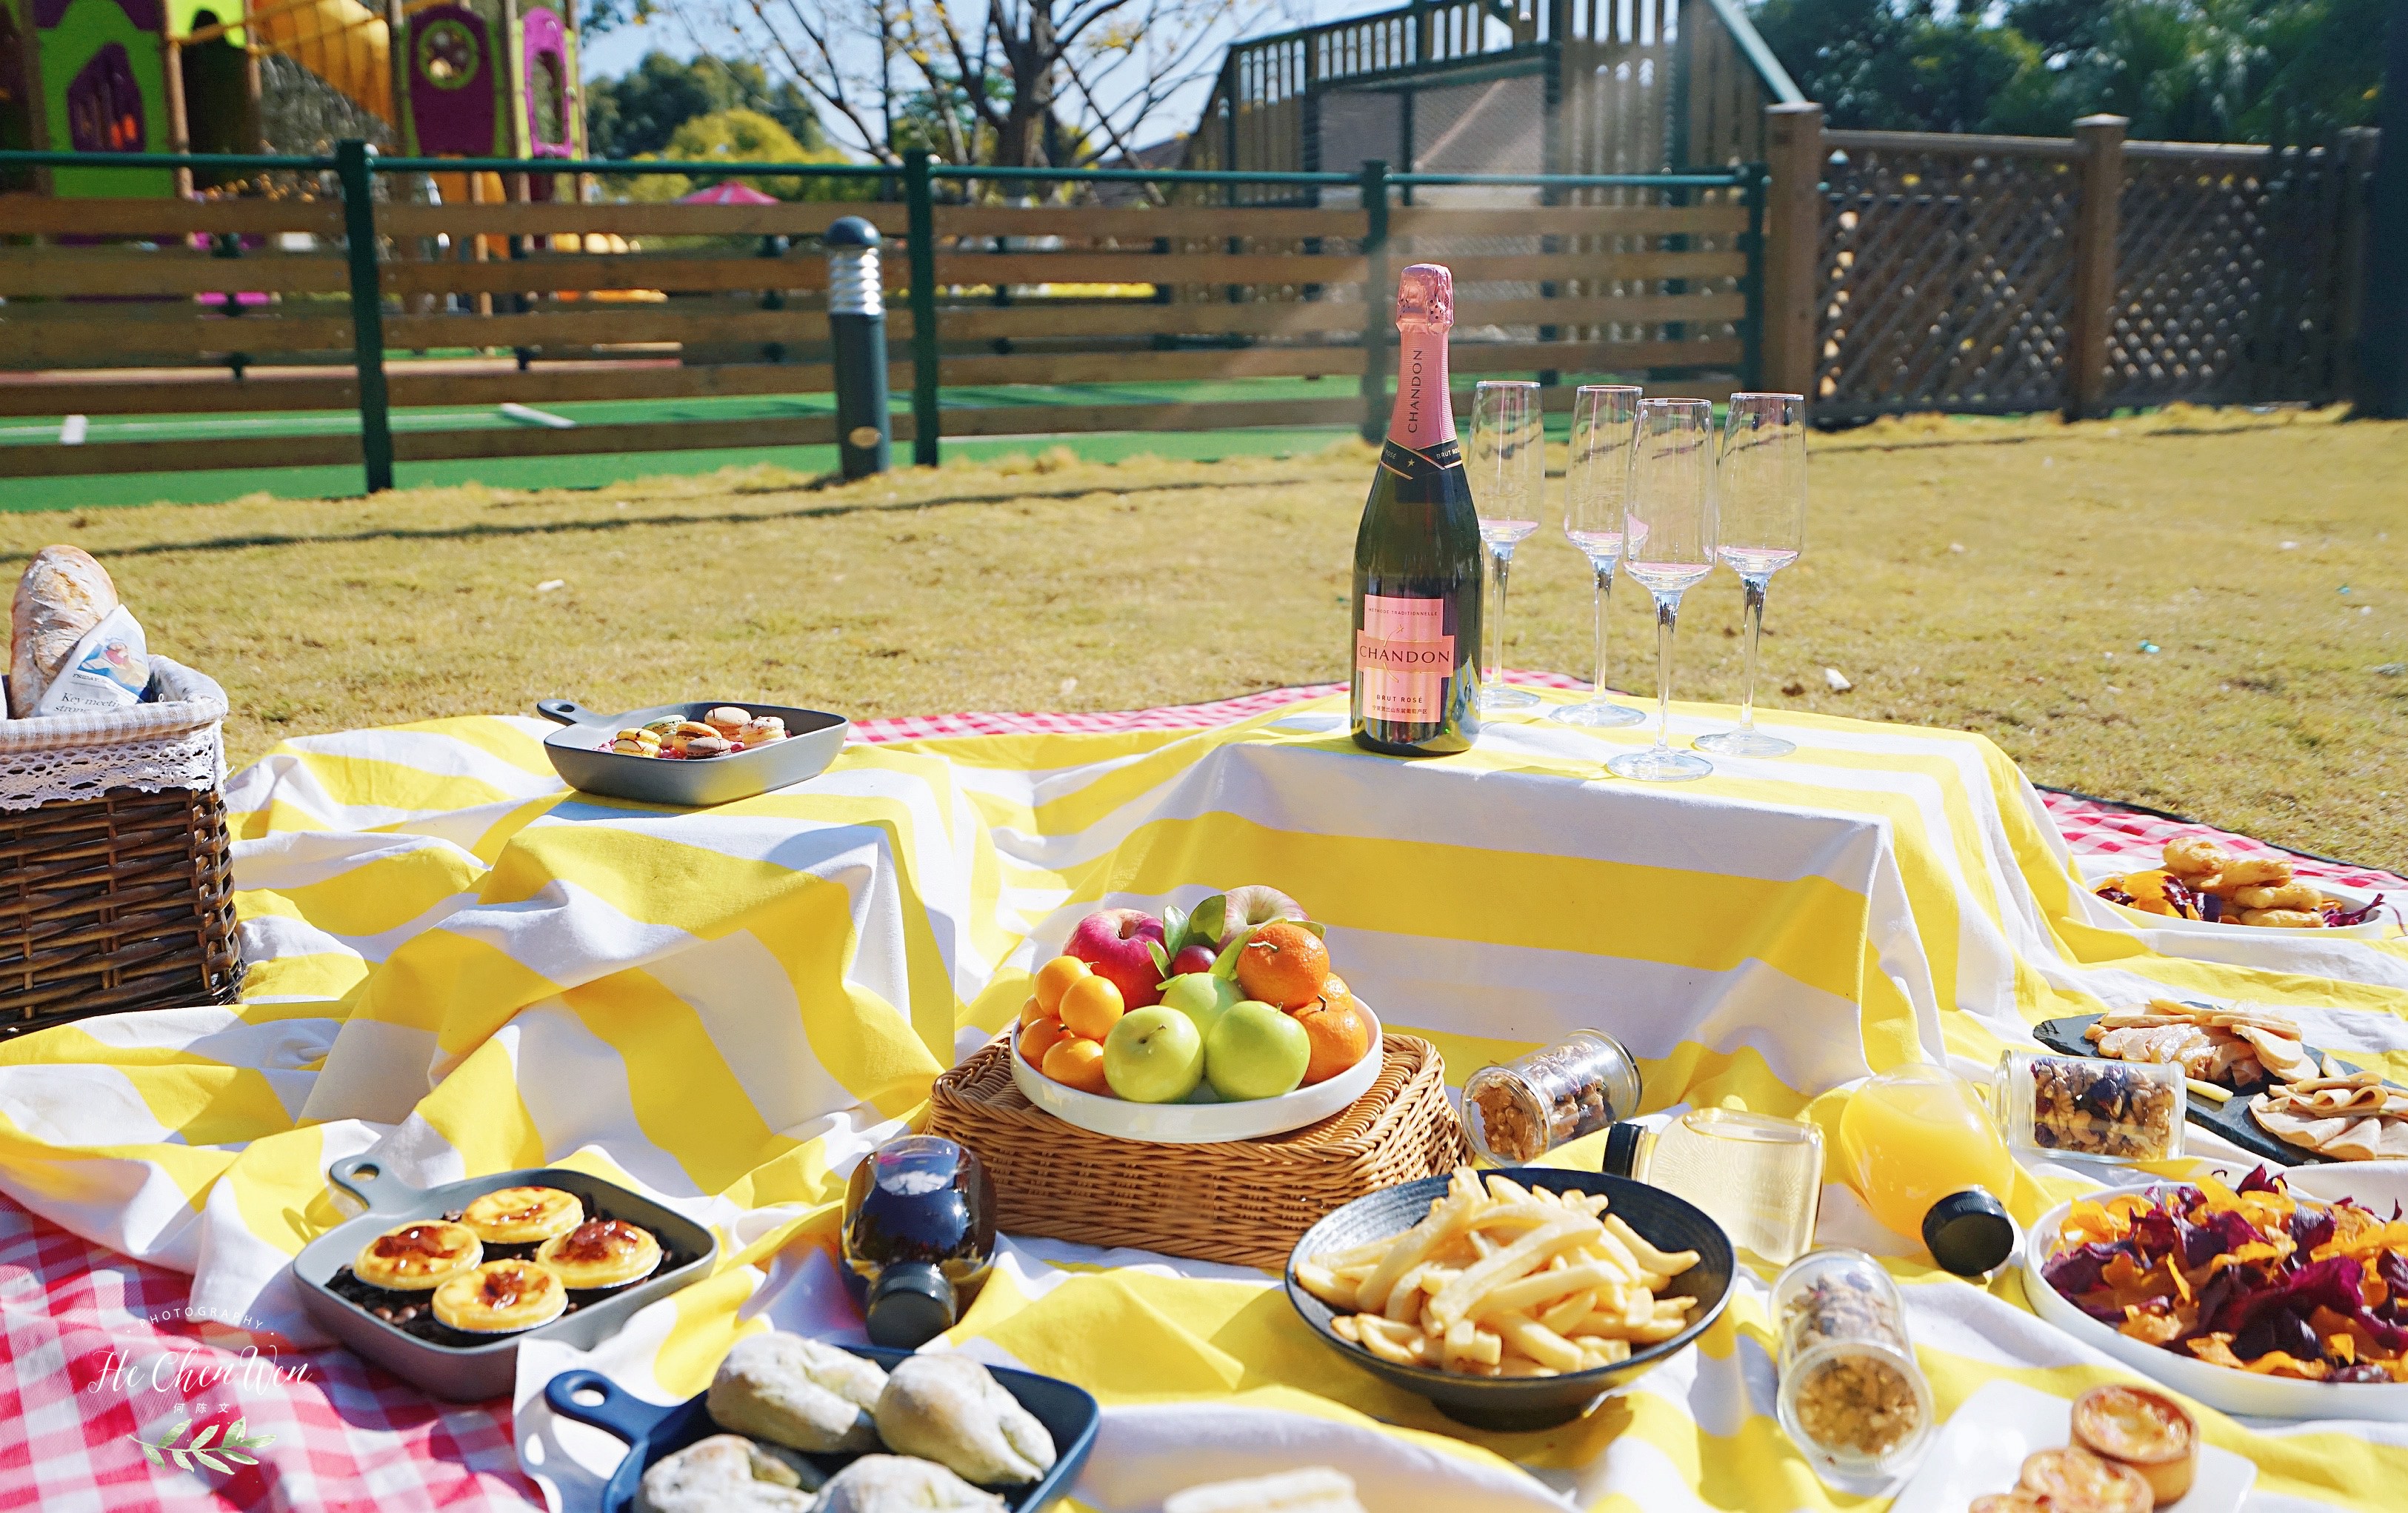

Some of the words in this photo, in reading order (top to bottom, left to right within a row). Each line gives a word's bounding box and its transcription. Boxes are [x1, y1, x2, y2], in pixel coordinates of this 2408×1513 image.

[1407, 350, 1422, 433] CHANDON
[1436, 451, 1452, 459] BRUT
[1359, 645, 1450, 664] CHANDON
[61, 692, 81, 704] Key
[1376, 694, 1397, 702] BRUT
